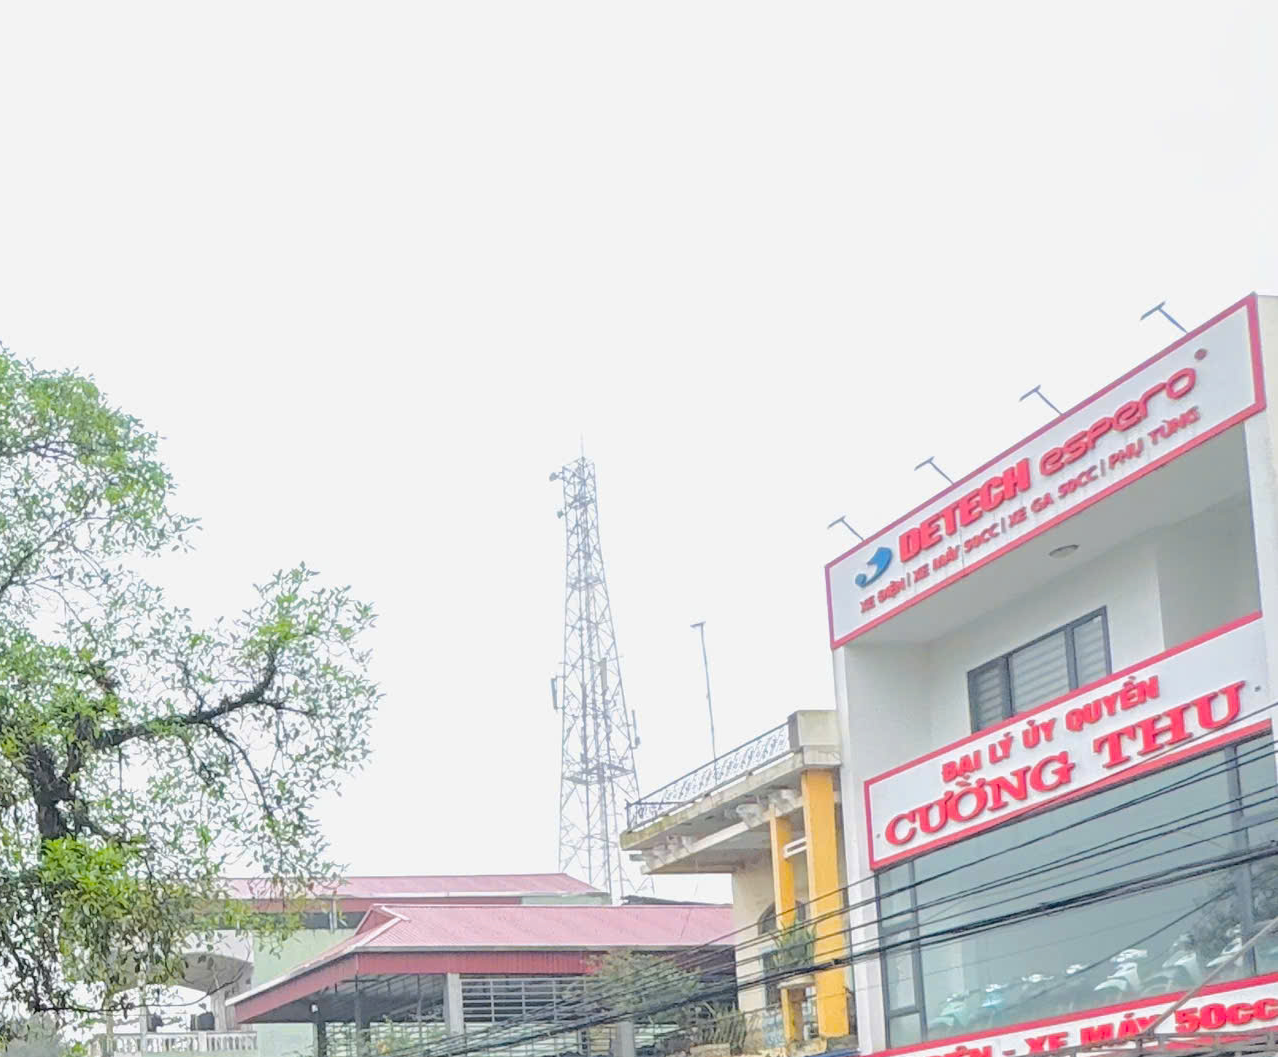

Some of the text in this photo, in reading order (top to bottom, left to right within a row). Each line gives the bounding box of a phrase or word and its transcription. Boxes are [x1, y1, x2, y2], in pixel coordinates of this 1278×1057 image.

[860, 595, 876, 614] XE
[913, 563, 930, 583] XE
[1008, 506, 1027, 528] XE
[1031, 492, 1054, 513] GA
[1058, 465, 1099, 499] 50CC
[899, 367, 1197, 563] DETECH espero
[885, 680, 1246, 846] CƯỜNG THU
[941, 675, 1160, 783] ĐẠI LÝ ỦY QUYỀN
[1025, 1031, 1069, 1055] XE
